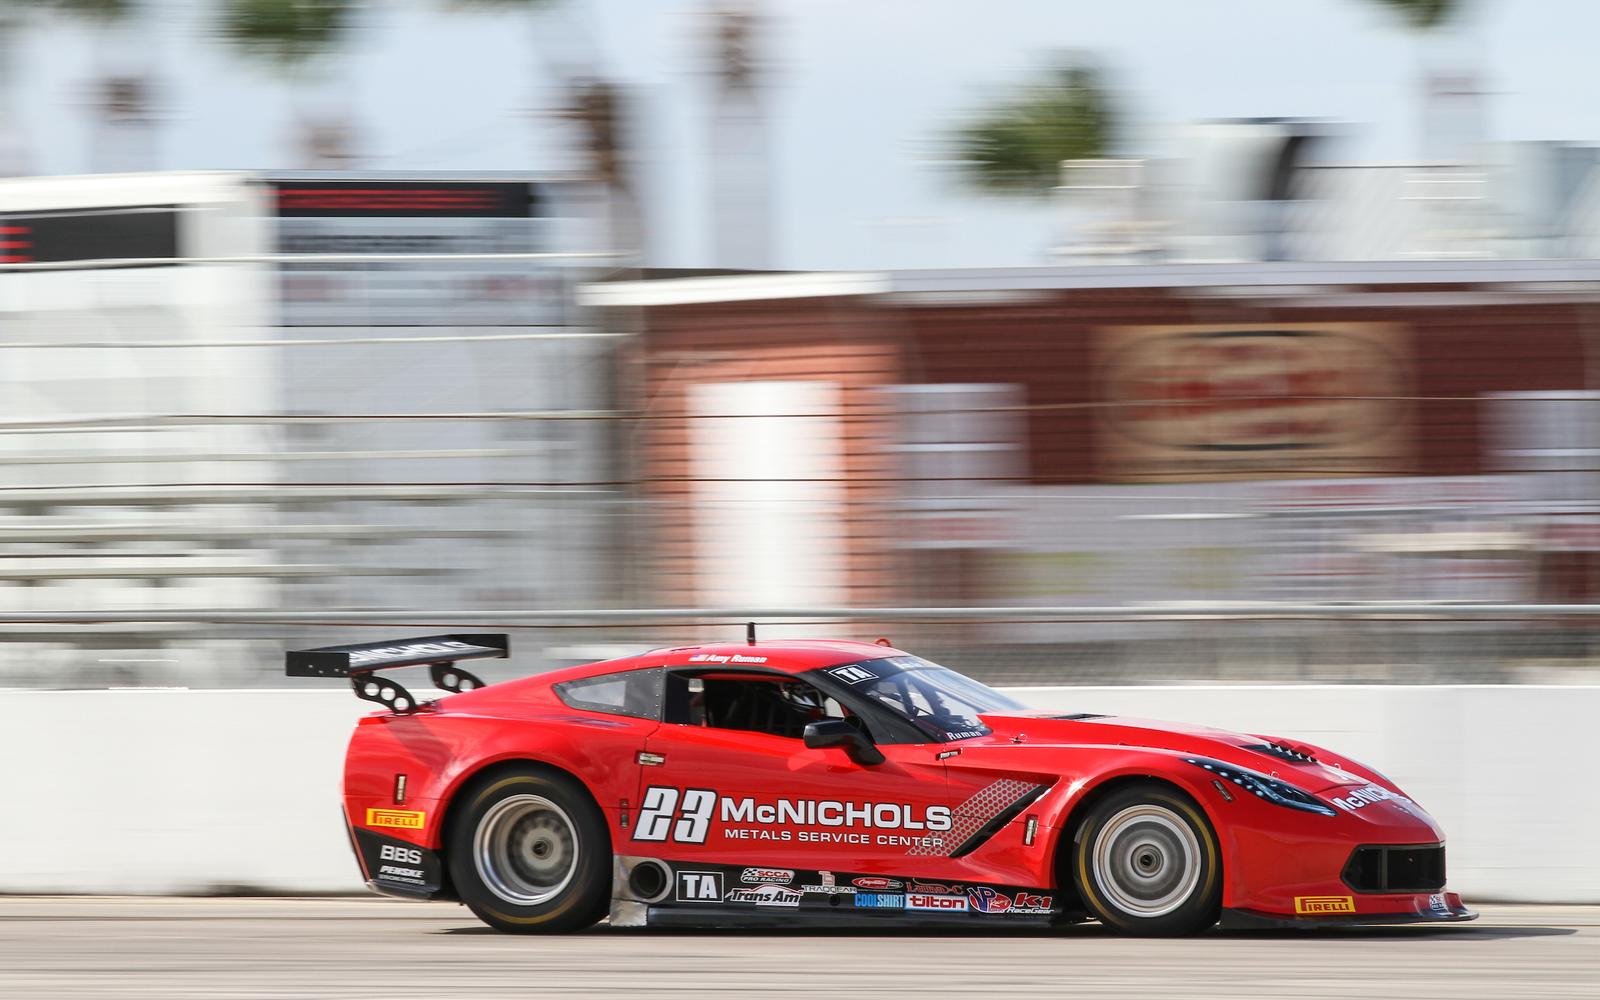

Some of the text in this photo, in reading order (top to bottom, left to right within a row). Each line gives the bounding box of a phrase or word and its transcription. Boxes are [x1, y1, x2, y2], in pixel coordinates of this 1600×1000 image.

[705, 654, 768, 664] Amy Ruman
[834, 667, 873, 681] TA
[946, 731, 982, 740] Ruman
[372, 811, 420, 826] PIRELLI
[631, 785, 718, 844] 23
[720, 797, 952, 831] McNICHOLS
[724, 829, 944, 848] METALS SERVICE CENTER
[380, 845, 422, 865] BBS
[757, 870, 790, 878] SCCA
[682, 874, 718, 899] TA
[730, 889, 800, 903] Trans Am
[855, 894, 904, 908] COOLSHIRT
[909, 896, 965, 909] tilton
[967, 887, 997, 912] VP
[1013, 893, 1052, 909] K1
[1301, 898, 1350, 912] PIRELLI
